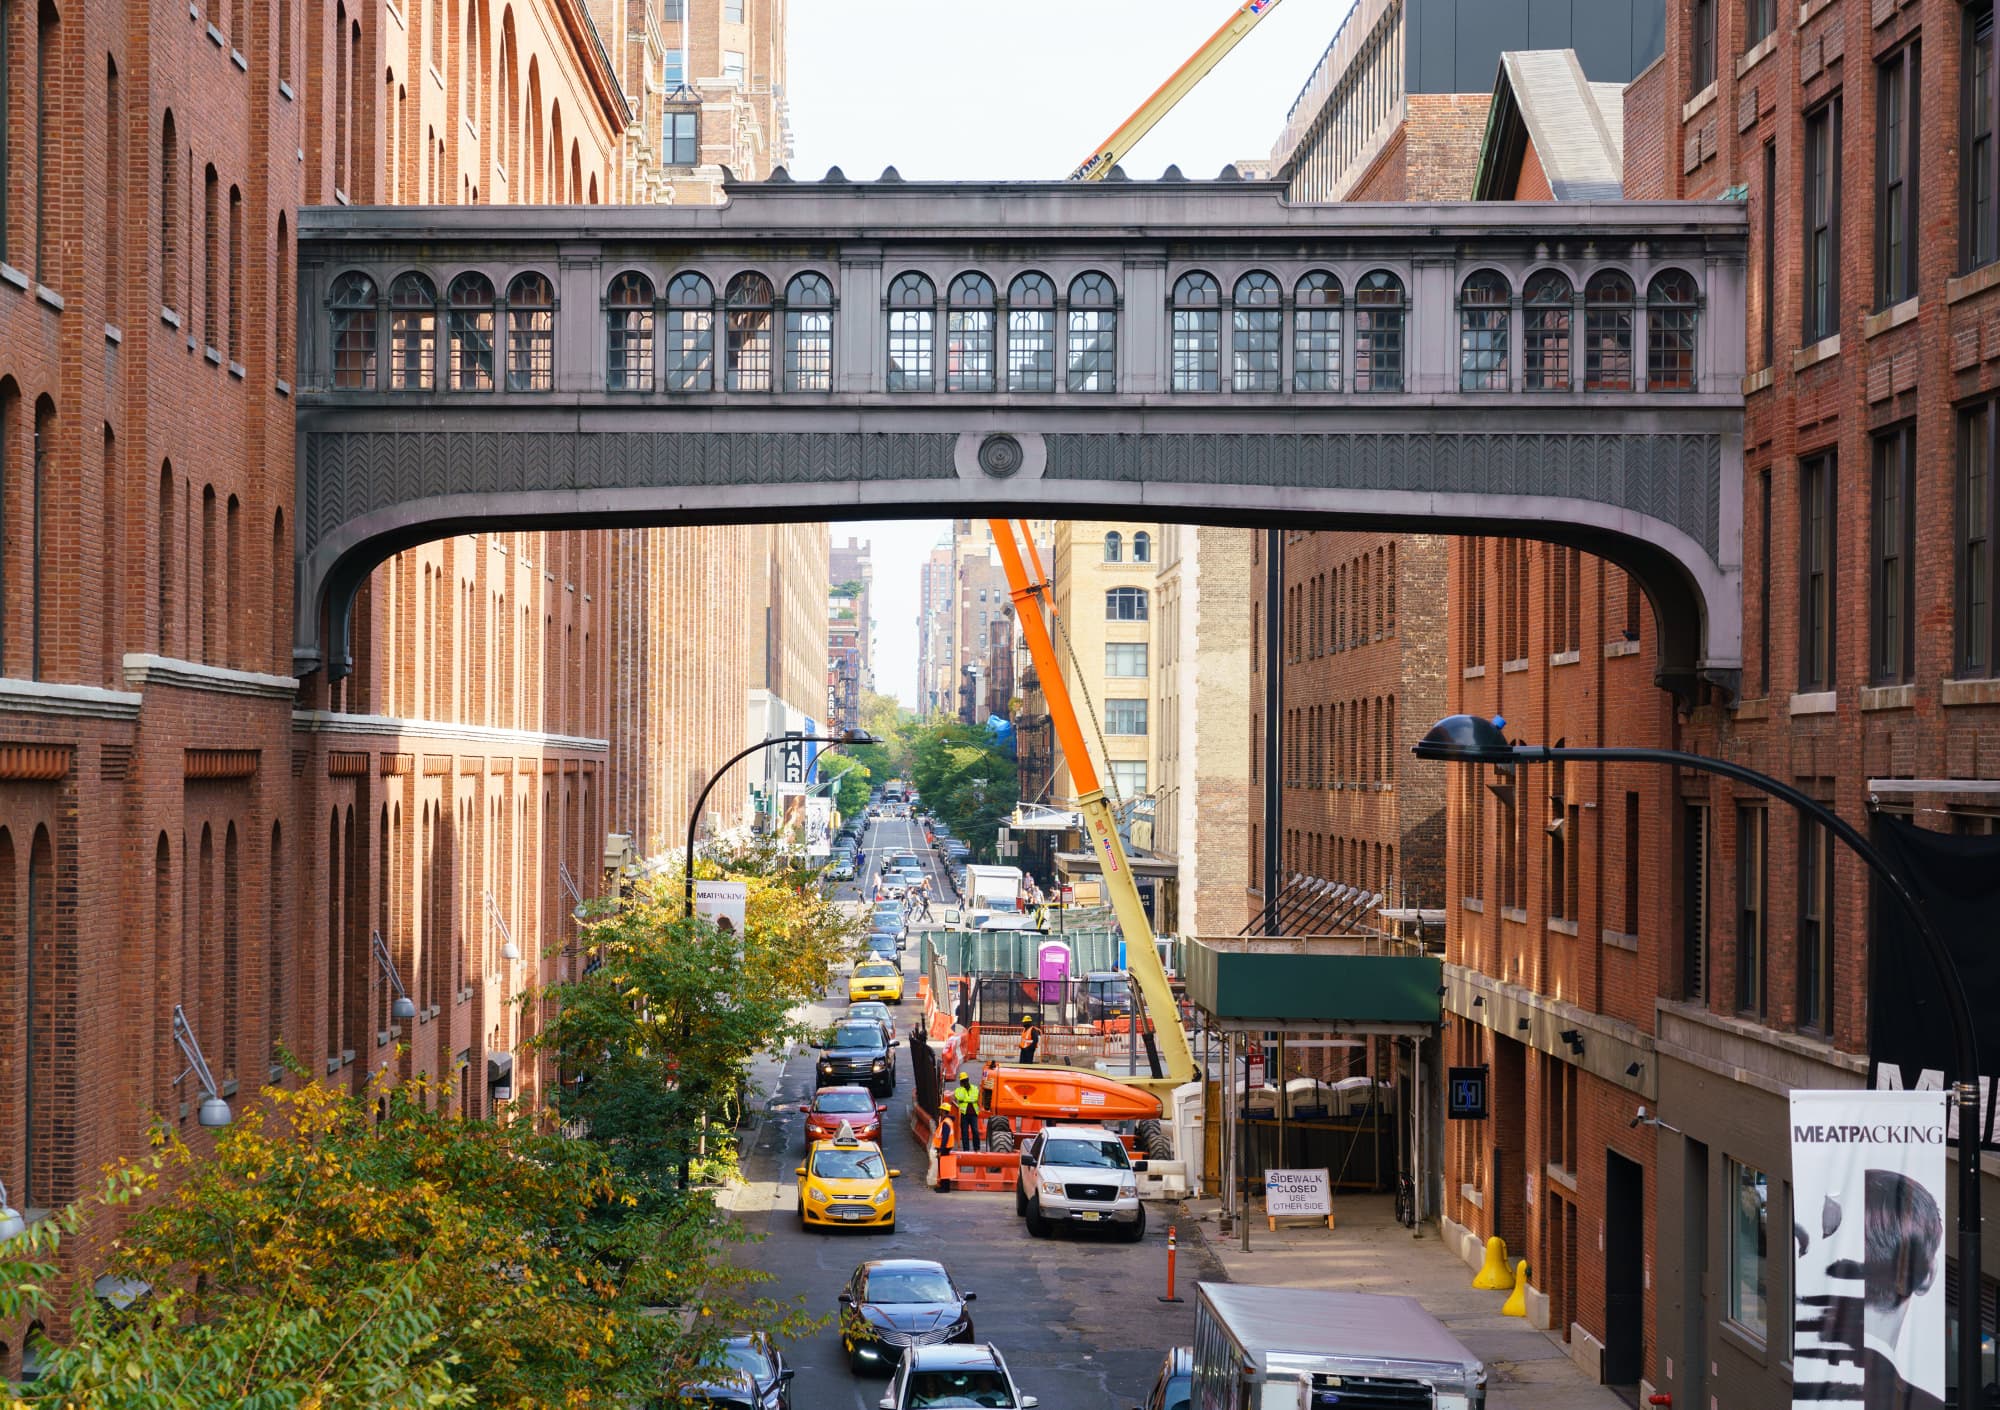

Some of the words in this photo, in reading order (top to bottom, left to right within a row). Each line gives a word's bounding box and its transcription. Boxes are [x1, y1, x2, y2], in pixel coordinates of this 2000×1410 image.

[827, 686, 835, 717] PARK
[1794, 1125, 1943, 1145] MEATPACKING
[1270, 1175, 1322, 1183] SIDEWALK
[1277, 1184, 1318, 1193] CLOSED
[1289, 1194, 1306, 1202] USE
[1273, 1202, 1302, 1210] OTHER
[1304, 1202, 1325, 1210] SIDE
